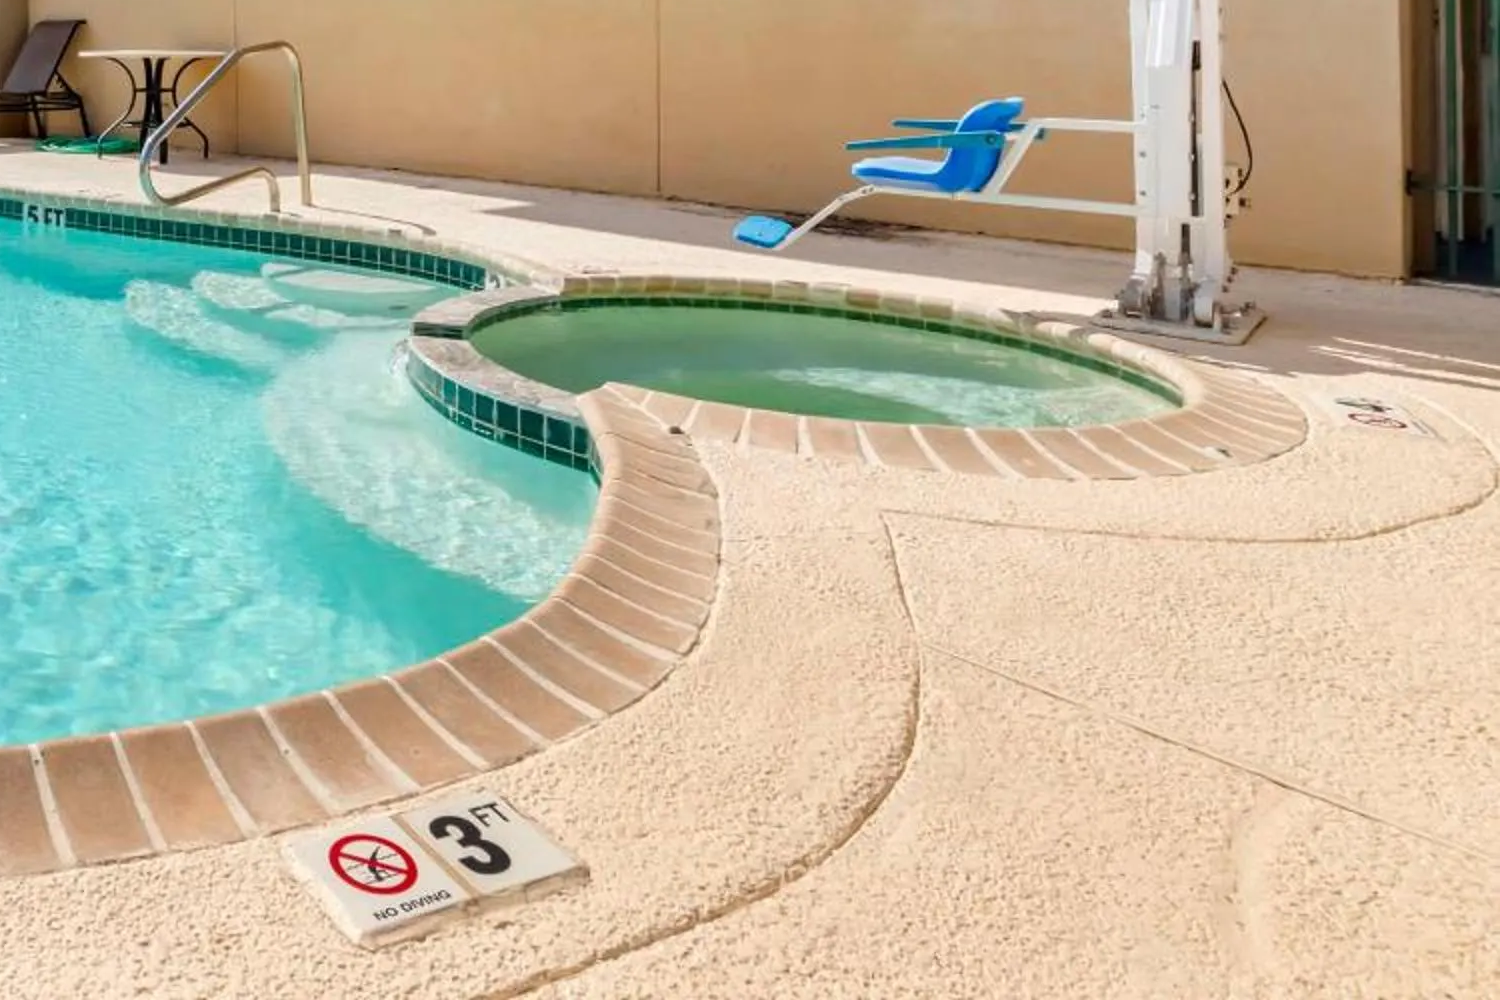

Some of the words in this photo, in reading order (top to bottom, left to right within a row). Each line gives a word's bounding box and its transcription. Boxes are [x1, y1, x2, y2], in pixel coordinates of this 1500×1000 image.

[27, 204, 39, 223] 5
[43, 207, 64, 226] FT
[468, 801, 511, 828] FT
[429, 815, 511, 875] 3
[372, 907, 399, 921] NO
[400, 889, 452, 913] DIVING
